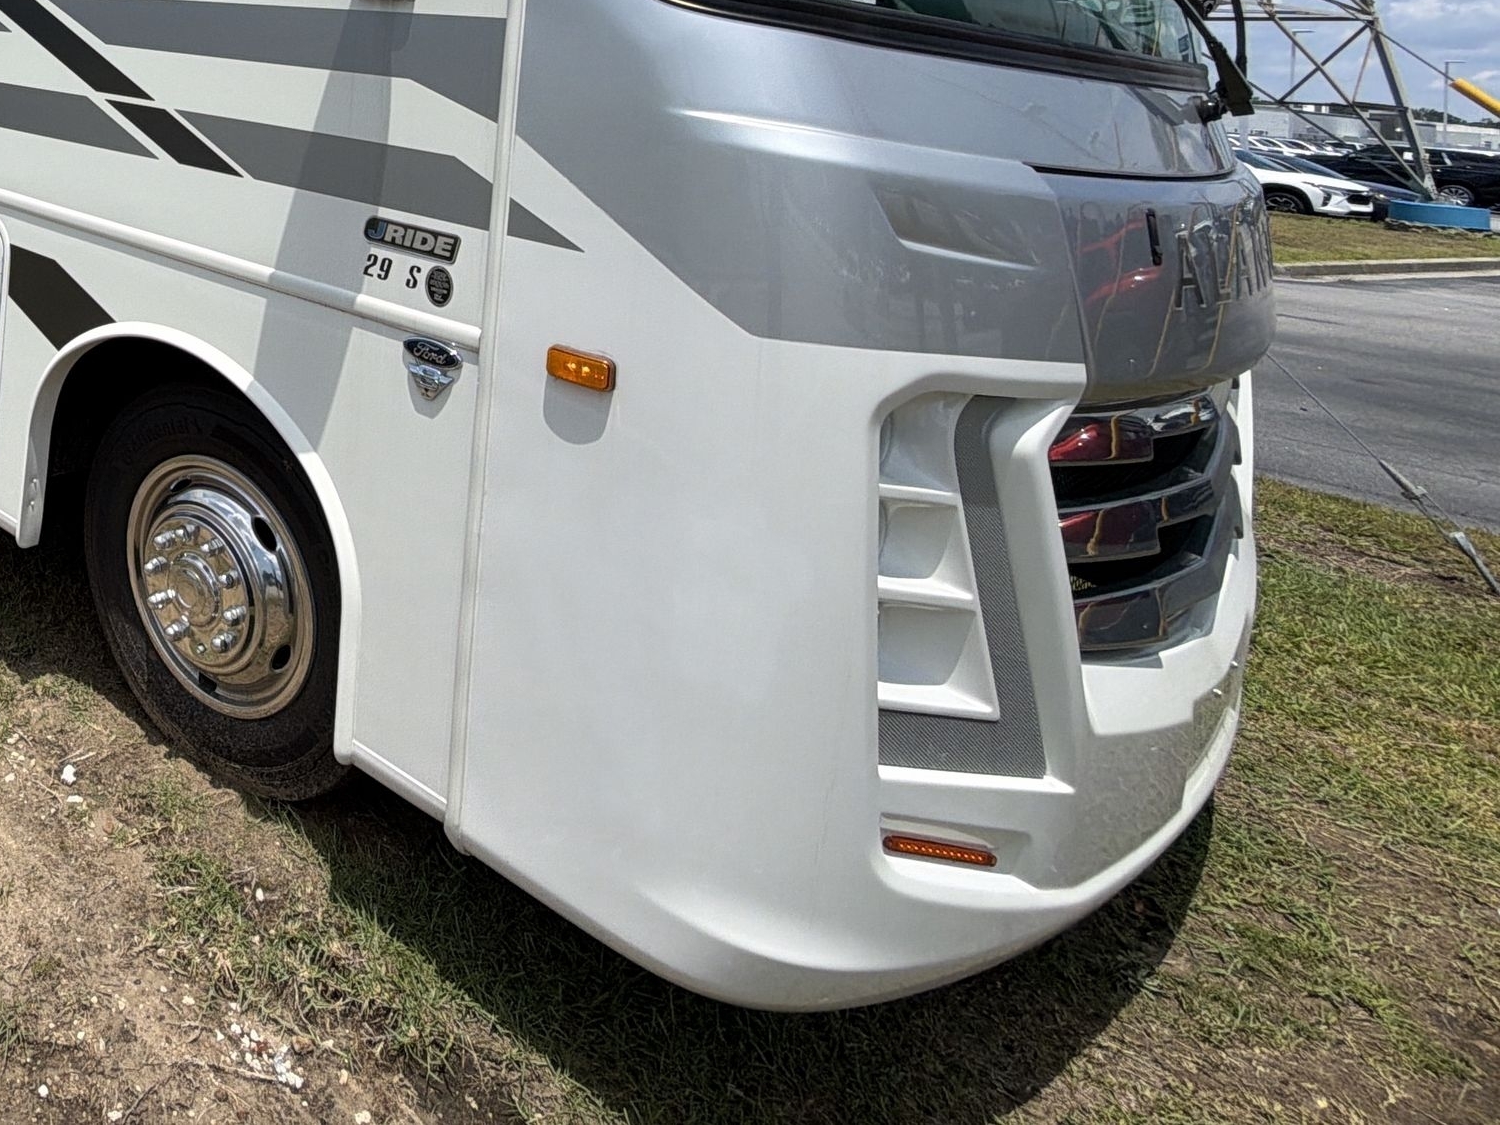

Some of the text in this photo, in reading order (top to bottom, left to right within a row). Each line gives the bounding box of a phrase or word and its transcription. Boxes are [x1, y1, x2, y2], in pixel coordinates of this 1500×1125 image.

[367, 220, 455, 257] JRIDE
[363, 253, 393, 281] 29
[405, 265, 422, 289] S
[413, 342, 448, 365] Ford
